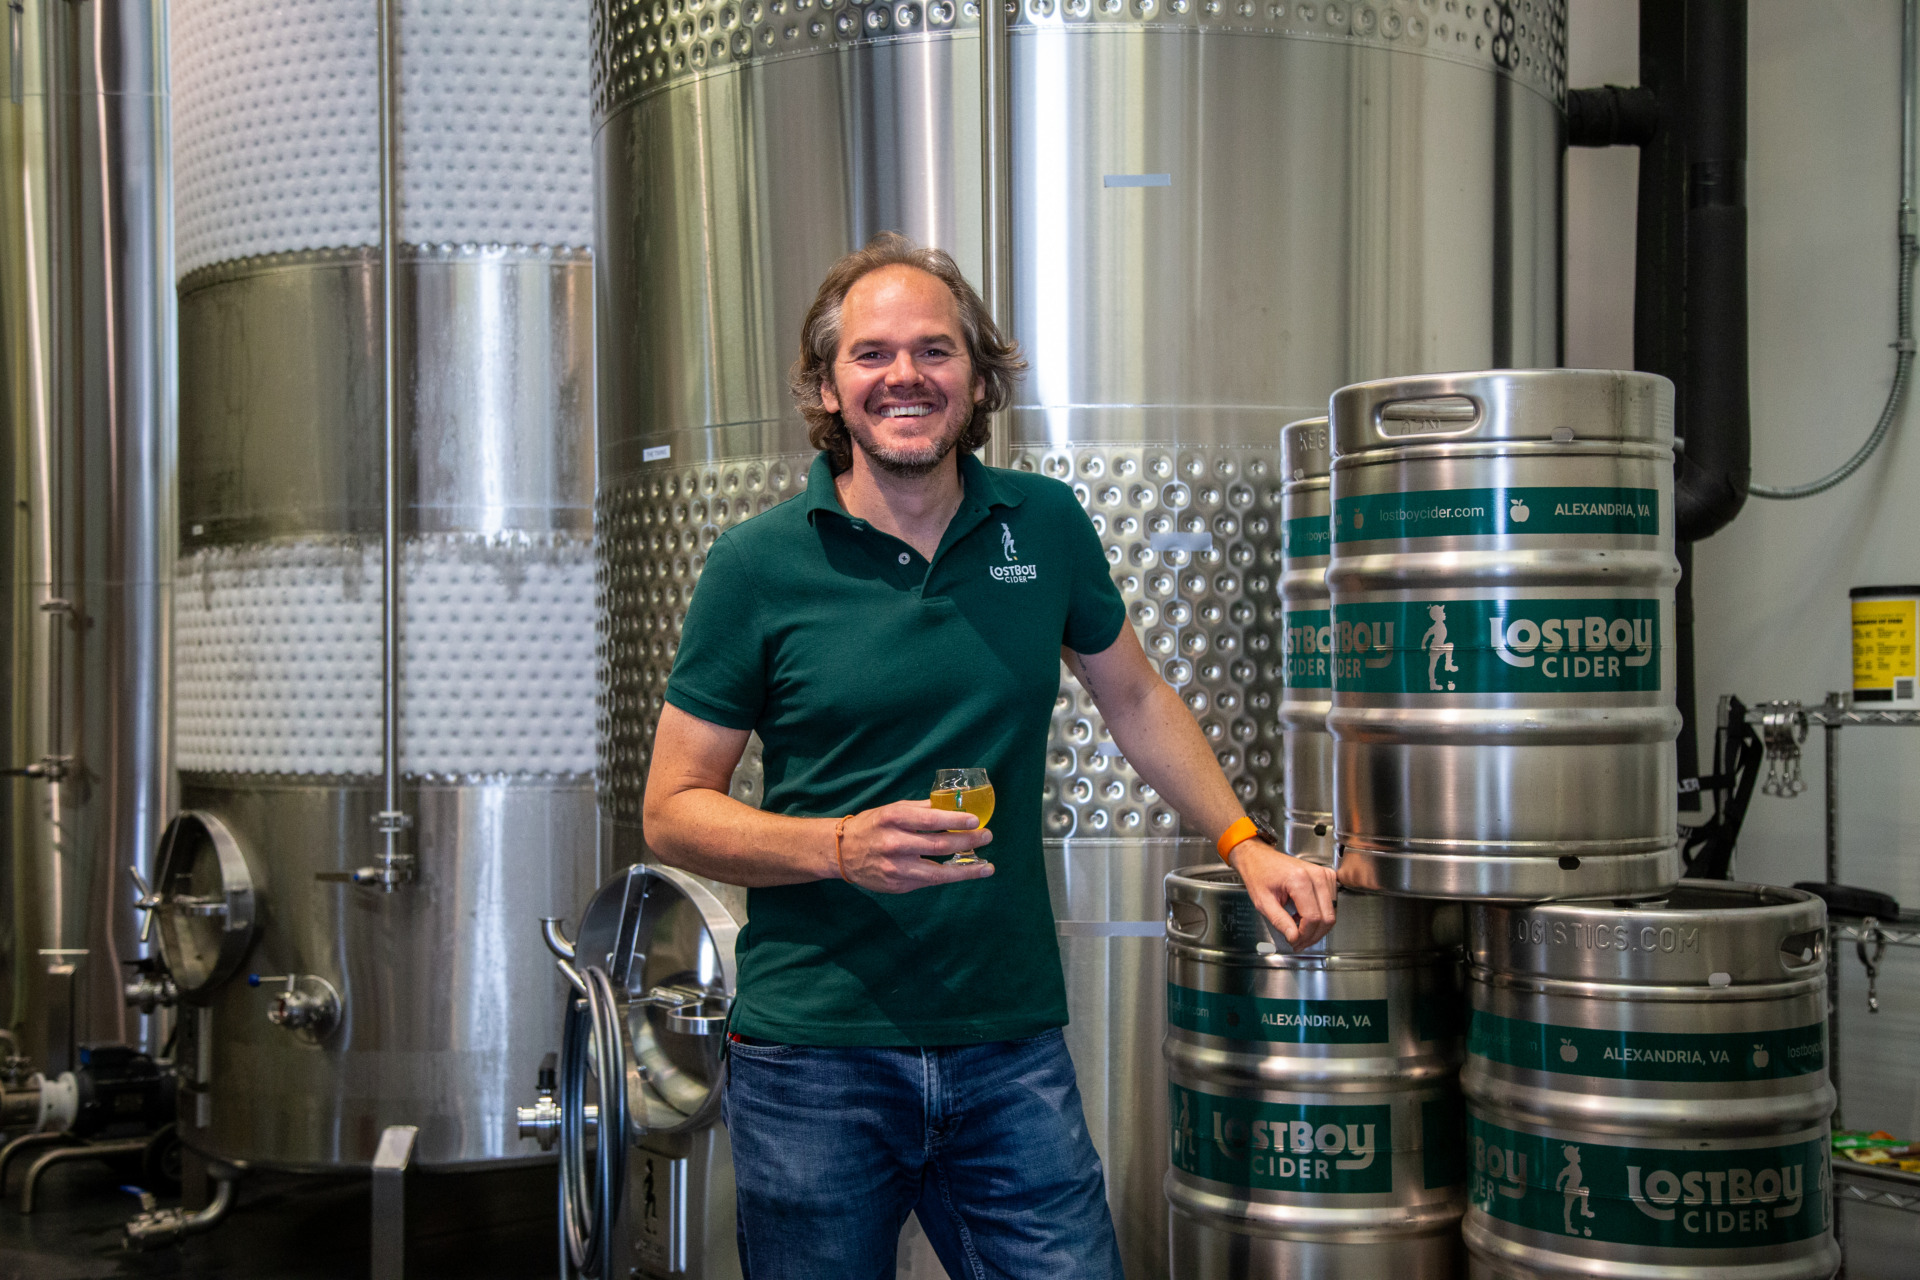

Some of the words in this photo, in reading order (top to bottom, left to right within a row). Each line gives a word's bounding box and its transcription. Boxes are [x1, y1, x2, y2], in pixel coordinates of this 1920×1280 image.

[1379, 506, 1485, 523] lostboycider.com
[1554, 503, 1636, 518] ALEXANDRIA,
[1638, 504, 1650, 517] VA
[989, 564, 1037, 580] LOSTBOY
[1489, 616, 1653, 668] LOSTBOY
[1541, 656, 1621, 678] CIDER
[1260, 1013, 1349, 1029] ALEXANDRIA,
[1352, 1015, 1372, 1027] VA
[1603, 1046, 1706, 1066] ALEXANDRIA,
[1709, 1050, 1730, 1063] VA
[1213, 1111, 1376, 1170] LOSTBOY
[1252, 1155, 1330, 1179] CIDER
[1626, 1163, 1803, 1221] LOSTBOY
[1682, 1208, 1769, 1233] CIDER
